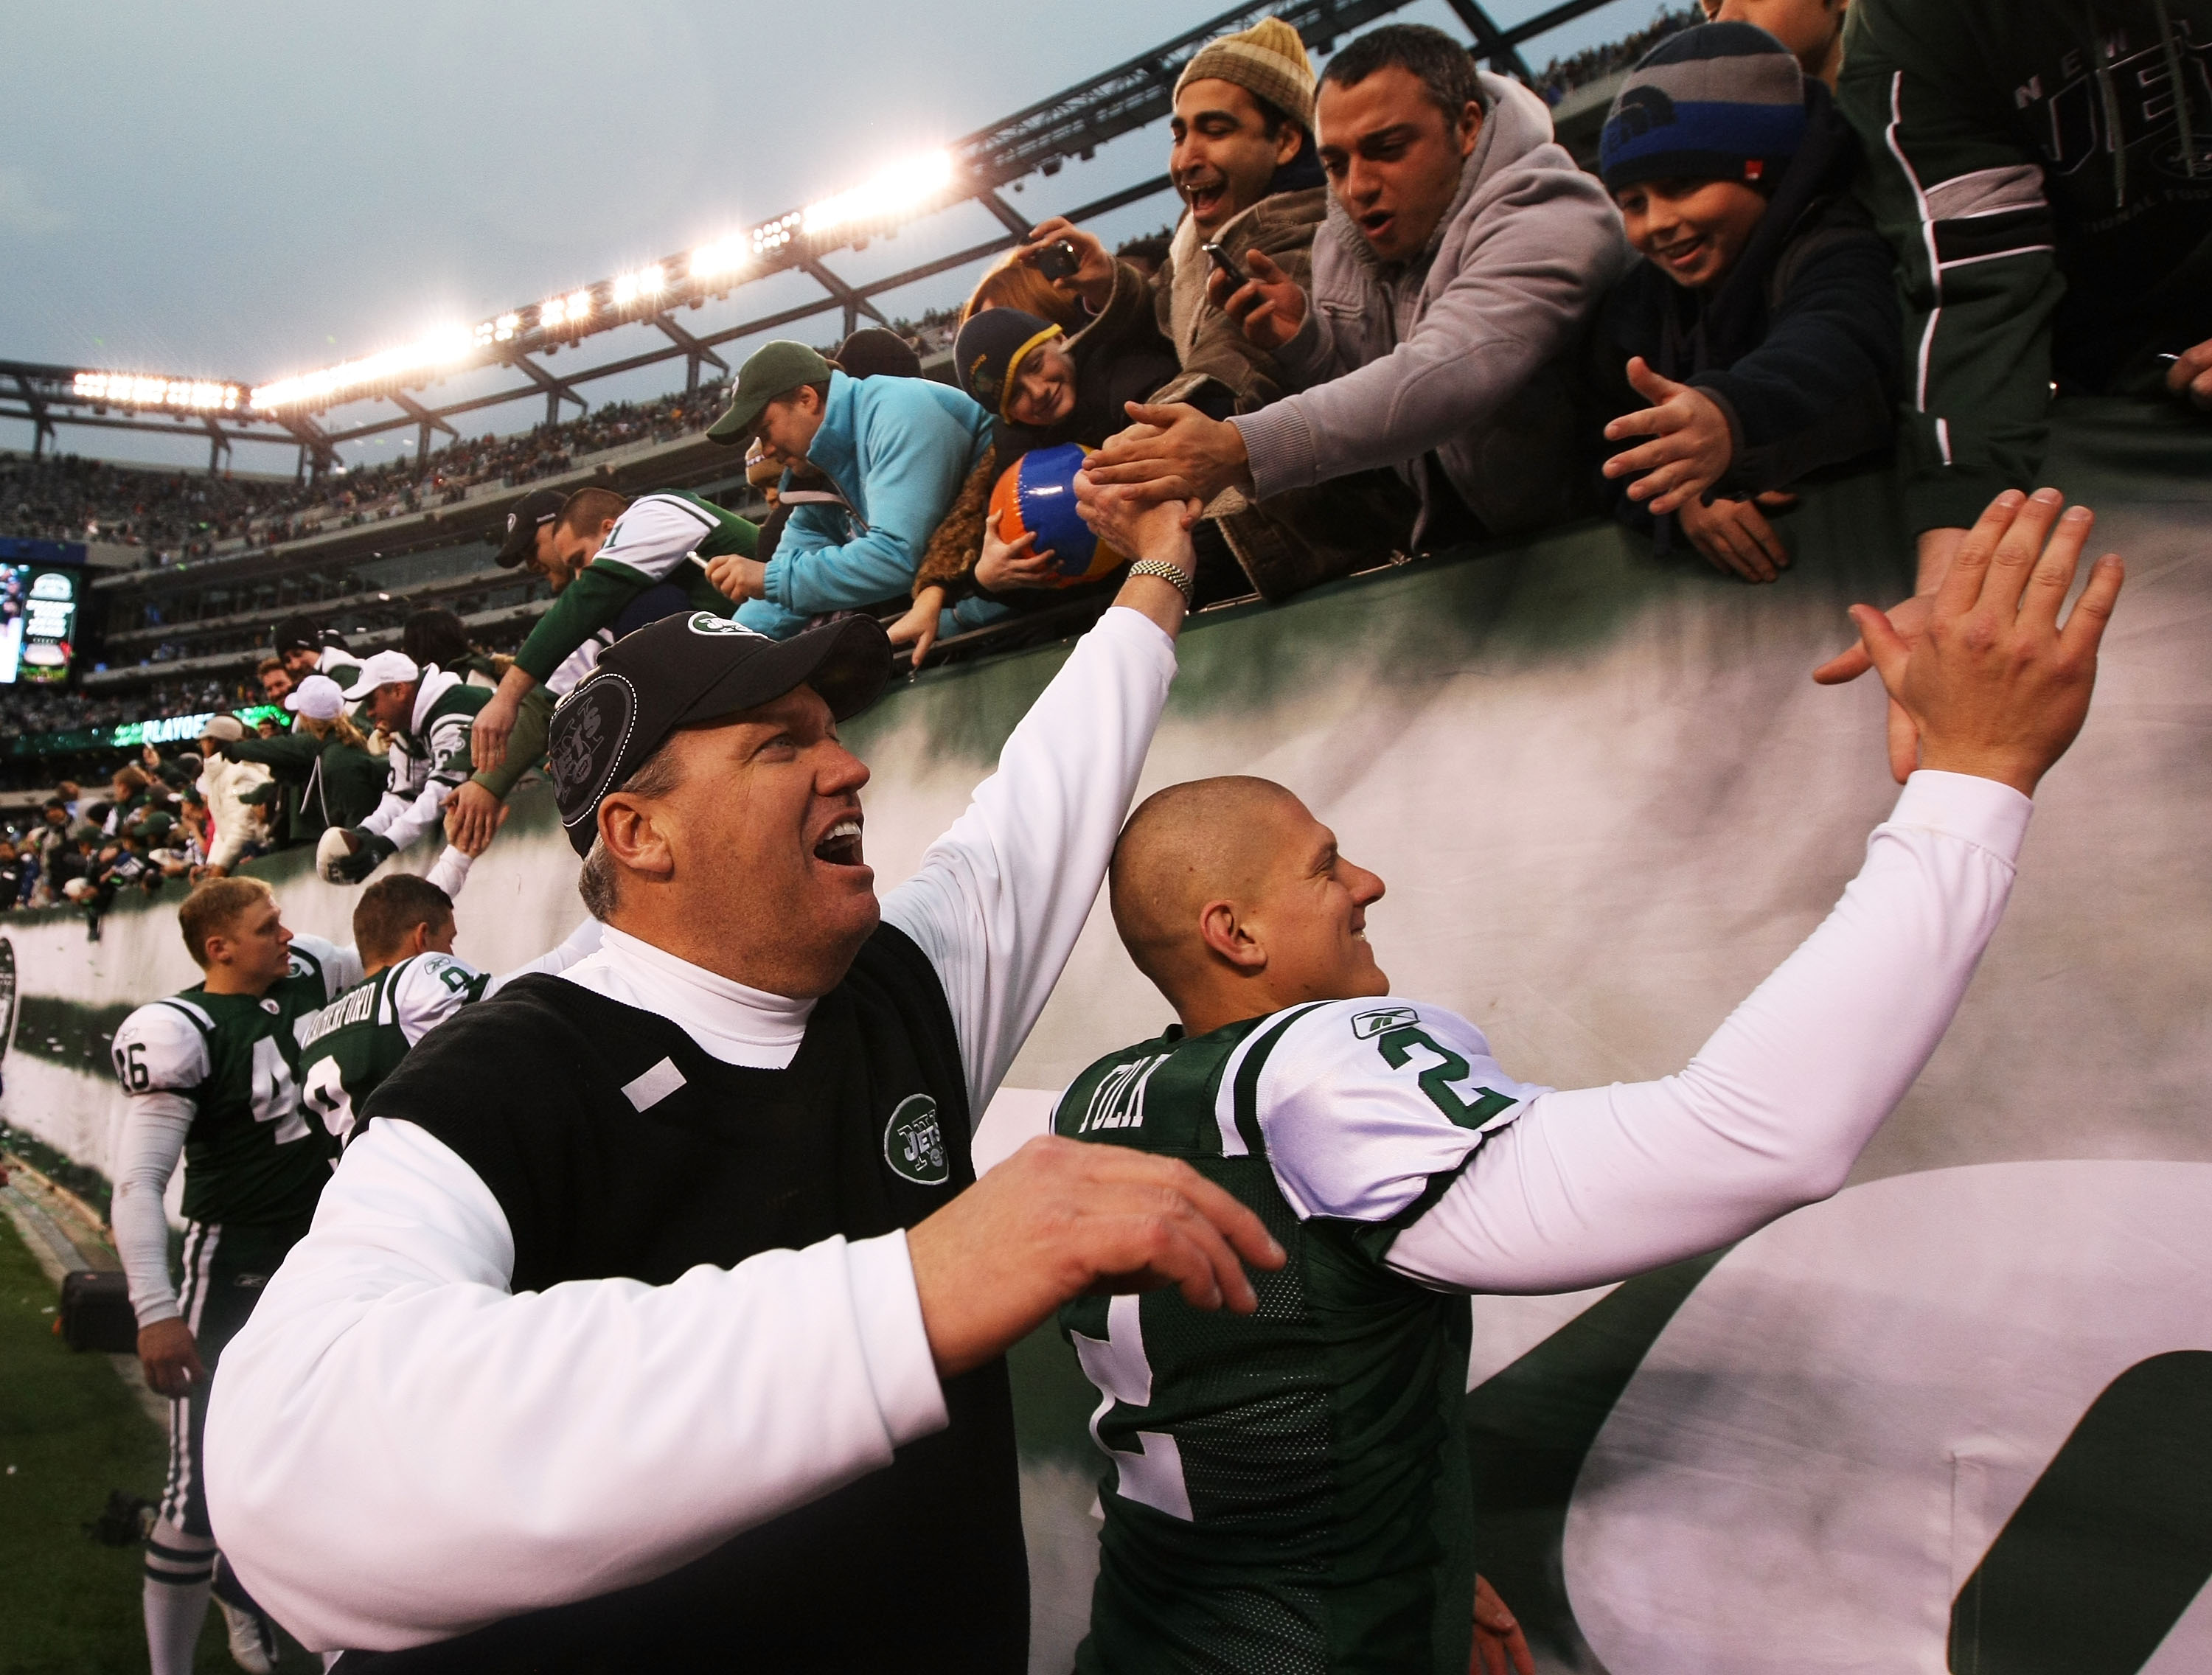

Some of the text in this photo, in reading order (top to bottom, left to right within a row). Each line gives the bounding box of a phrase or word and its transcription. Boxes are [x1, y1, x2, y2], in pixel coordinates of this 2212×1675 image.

[300, 981, 377, 1051] HERFORD
[1077, 1050, 1177, 1134] FOLK
[1377, 1026, 1520, 1131] 2
